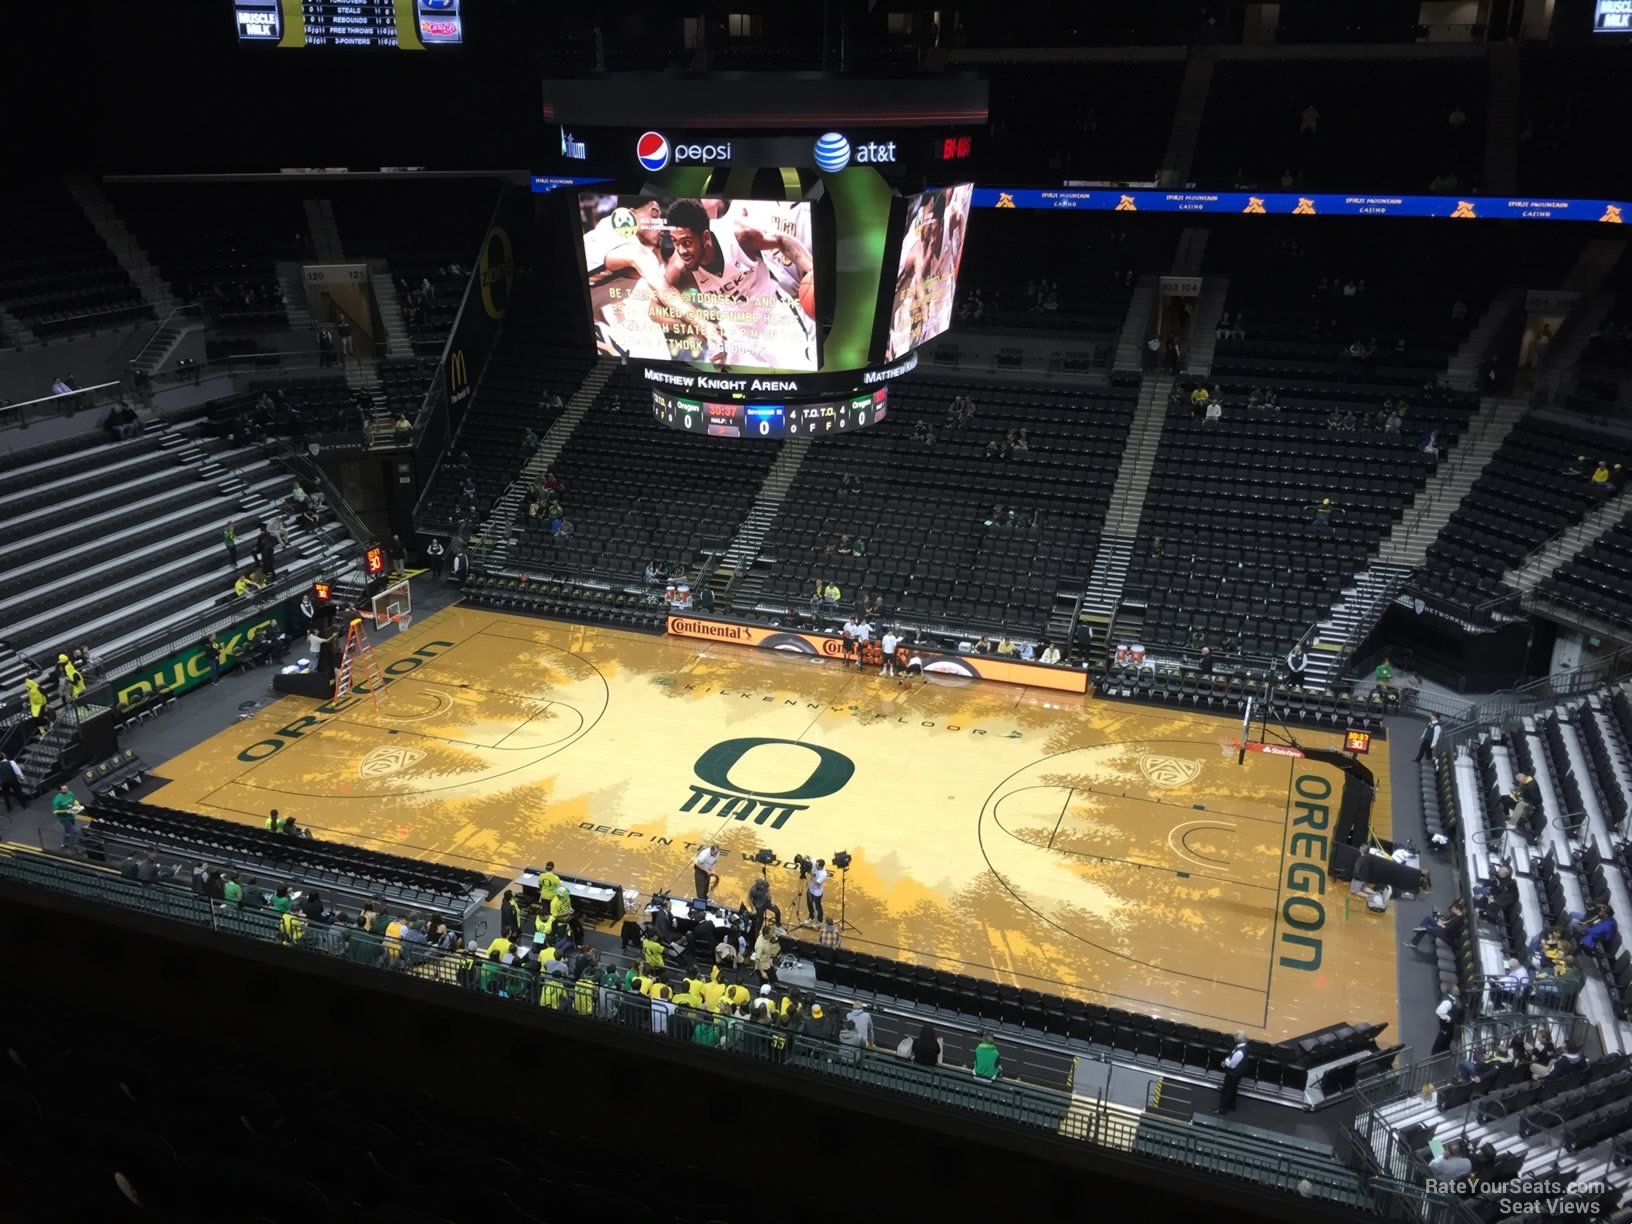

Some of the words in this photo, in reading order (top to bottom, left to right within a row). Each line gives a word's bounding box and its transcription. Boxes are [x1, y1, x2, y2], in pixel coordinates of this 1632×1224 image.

[1600, 0, 1632, 13] MUSCL
[238, 12, 276, 25] MUSCLE
[333, 16, 368, 24] REBOUNDS
[245, 23, 272, 36] MILK
[347, 27, 374, 35] THROWS
[675, 142, 731, 163] pepsi
[856, 141, 896, 163] at&t
[307, 272, 325, 281] 120
[348, 271, 364, 280] 121
[644, 368, 695, 387] MATTHEW
[697, 376, 747, 391] KNIGHT
[750, 379, 798, 391] ARENA
[863, 363, 905, 384] MATTHEW
[677, 401, 700, 412] Oregon
[708, 405, 738, 417] 30:37
[802, 409, 819, 418] T.O.
[820, 407, 834, 417] T.O.
[789, 409, 797, 420] 4
[858, 411, 866, 426] 0
[684, 414, 692, 429] 0
[759, 420, 770, 435] 0
[790, 424, 798, 434] 0
[671, 617, 741, 640] Continental
[684, 683, 846, 713] KILKENNY
[1351, 740, 1363, 749] 30
[578, 822, 644, 838] DEEP
[650, 835, 673, 846] IN
[1279, 774, 1332, 972] OREGON
